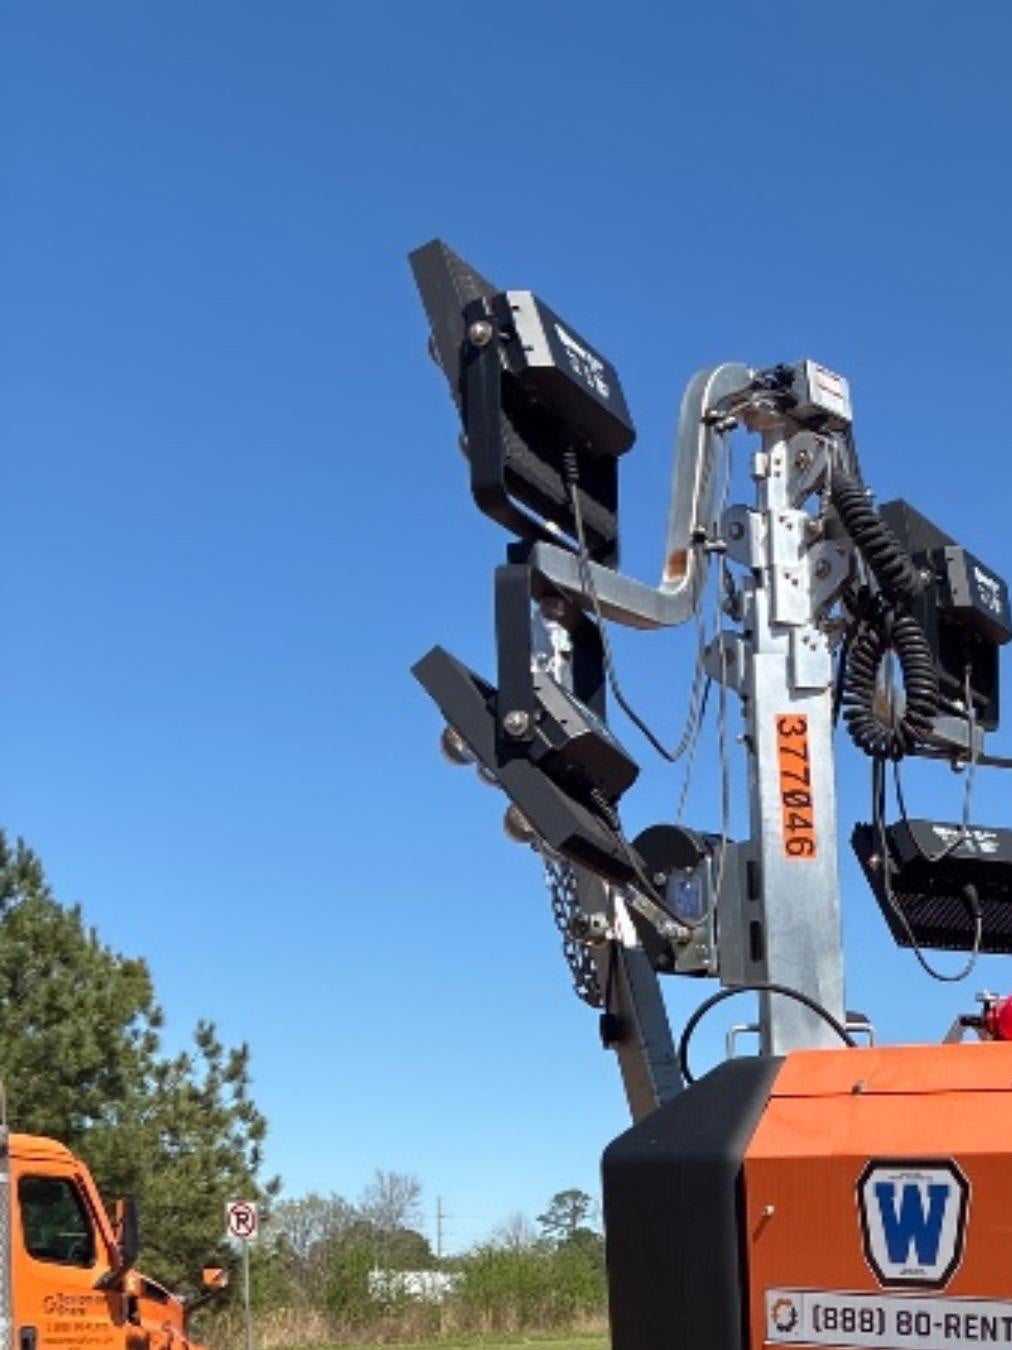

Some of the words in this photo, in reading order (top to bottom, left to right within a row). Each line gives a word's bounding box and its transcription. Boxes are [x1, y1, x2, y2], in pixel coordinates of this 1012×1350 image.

[777, 718, 815, 855] 377046
[874, 1182, 949, 1266] W
[812, 1304, 886, 1336] (888)
